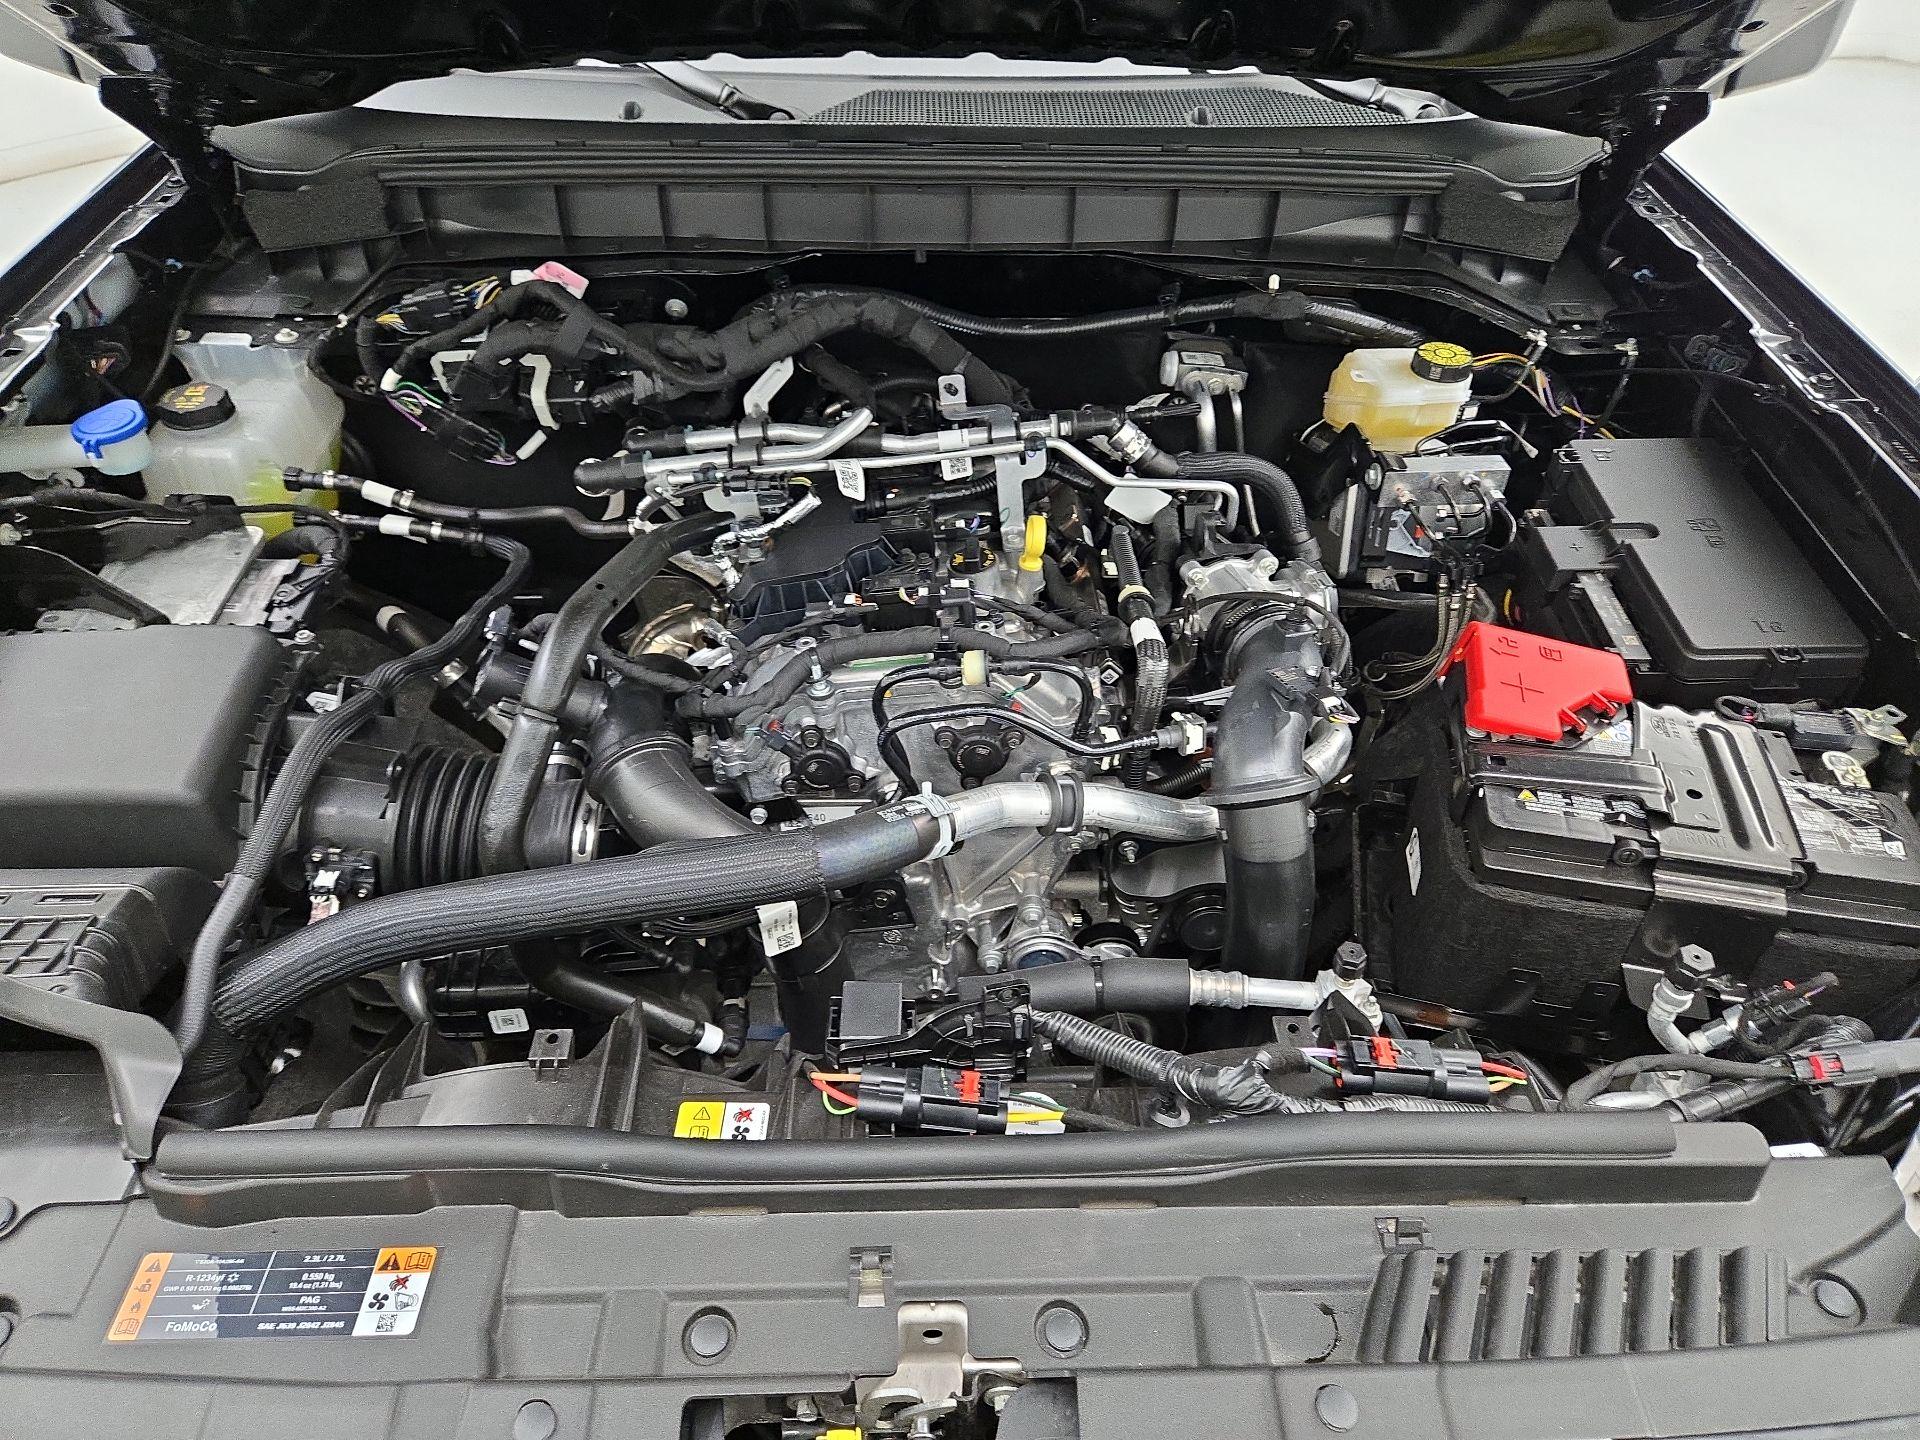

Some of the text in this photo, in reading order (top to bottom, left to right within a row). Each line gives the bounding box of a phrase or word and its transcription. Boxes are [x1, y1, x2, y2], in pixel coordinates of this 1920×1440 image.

[185, 1273, 227, 1283] R-1234yf
[323, 1272, 335, 1282] kg
[299, 1295, 321, 1304] PAG
[165, 1320, 218, 1332] FoMoCo
[256, 1322, 277, 1330] SAE
